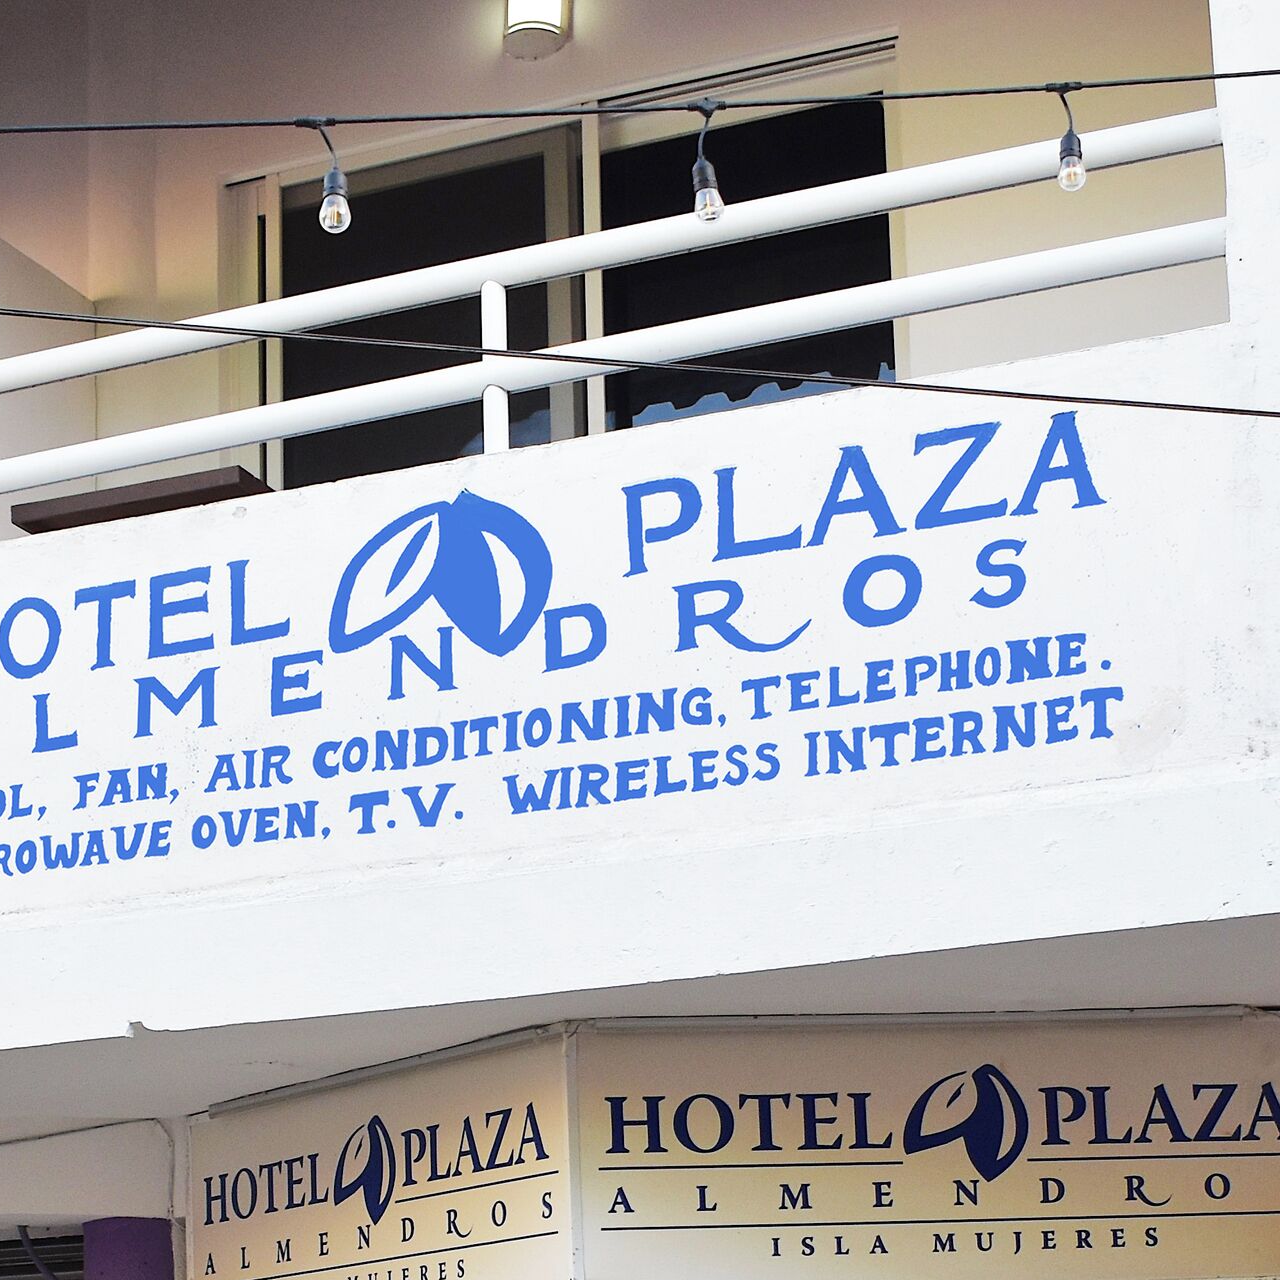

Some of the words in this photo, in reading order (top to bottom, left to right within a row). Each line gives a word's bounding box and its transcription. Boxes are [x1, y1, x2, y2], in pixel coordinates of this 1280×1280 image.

[622, 410, 1108, 577] PLAZA
[73, 761, 179, 810] FAN,
[204, 744, 293, 793] AIR
[312, 686, 727, 779] CONDITIONING,
[742, 632, 1111, 721] TELEPHONE.
[191, 798, 332, 849] OVEN,
[348, 782, 464, 834] T.V.
[503, 742, 781, 816] WIRELESS
[803, 686, 1124, 778] INTERNET
[204, 1152, 329, 1226] HOTEL
[401, 1102, 549, 1187] PLAZA
[604, 1092, 893, 1154] HOTEL
[205, 1191, 554, 1276] ALMENDROS
[771, 1234, 888, 1258] ISLA
[932, 1227, 1160, 1255] MUJERES
